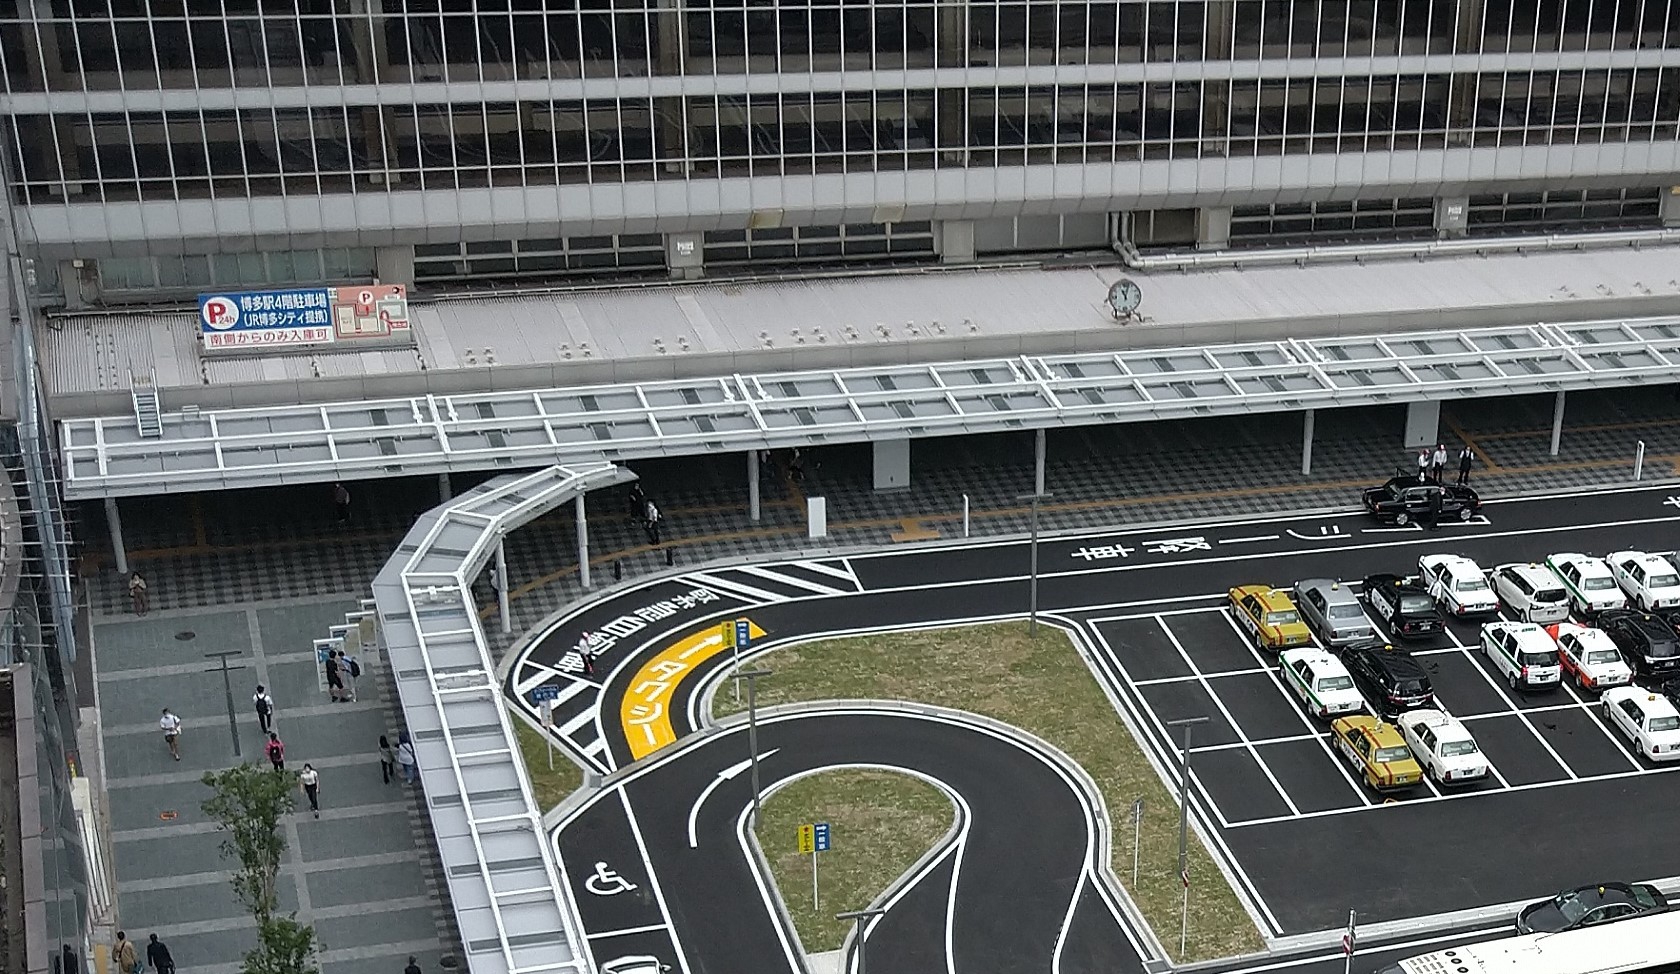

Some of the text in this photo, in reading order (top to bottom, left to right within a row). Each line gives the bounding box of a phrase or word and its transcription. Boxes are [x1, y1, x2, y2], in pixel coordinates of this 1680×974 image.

[240, 292, 327, 313] 博多駅4階駐車場
[362, 292, 370, 304] P
[207, 302, 227, 325] P
[218, 314, 236, 325] 24h
[209, 328, 329, 347] 南側からのみ入庫可
[628, 659, 690, 746] タクシー
